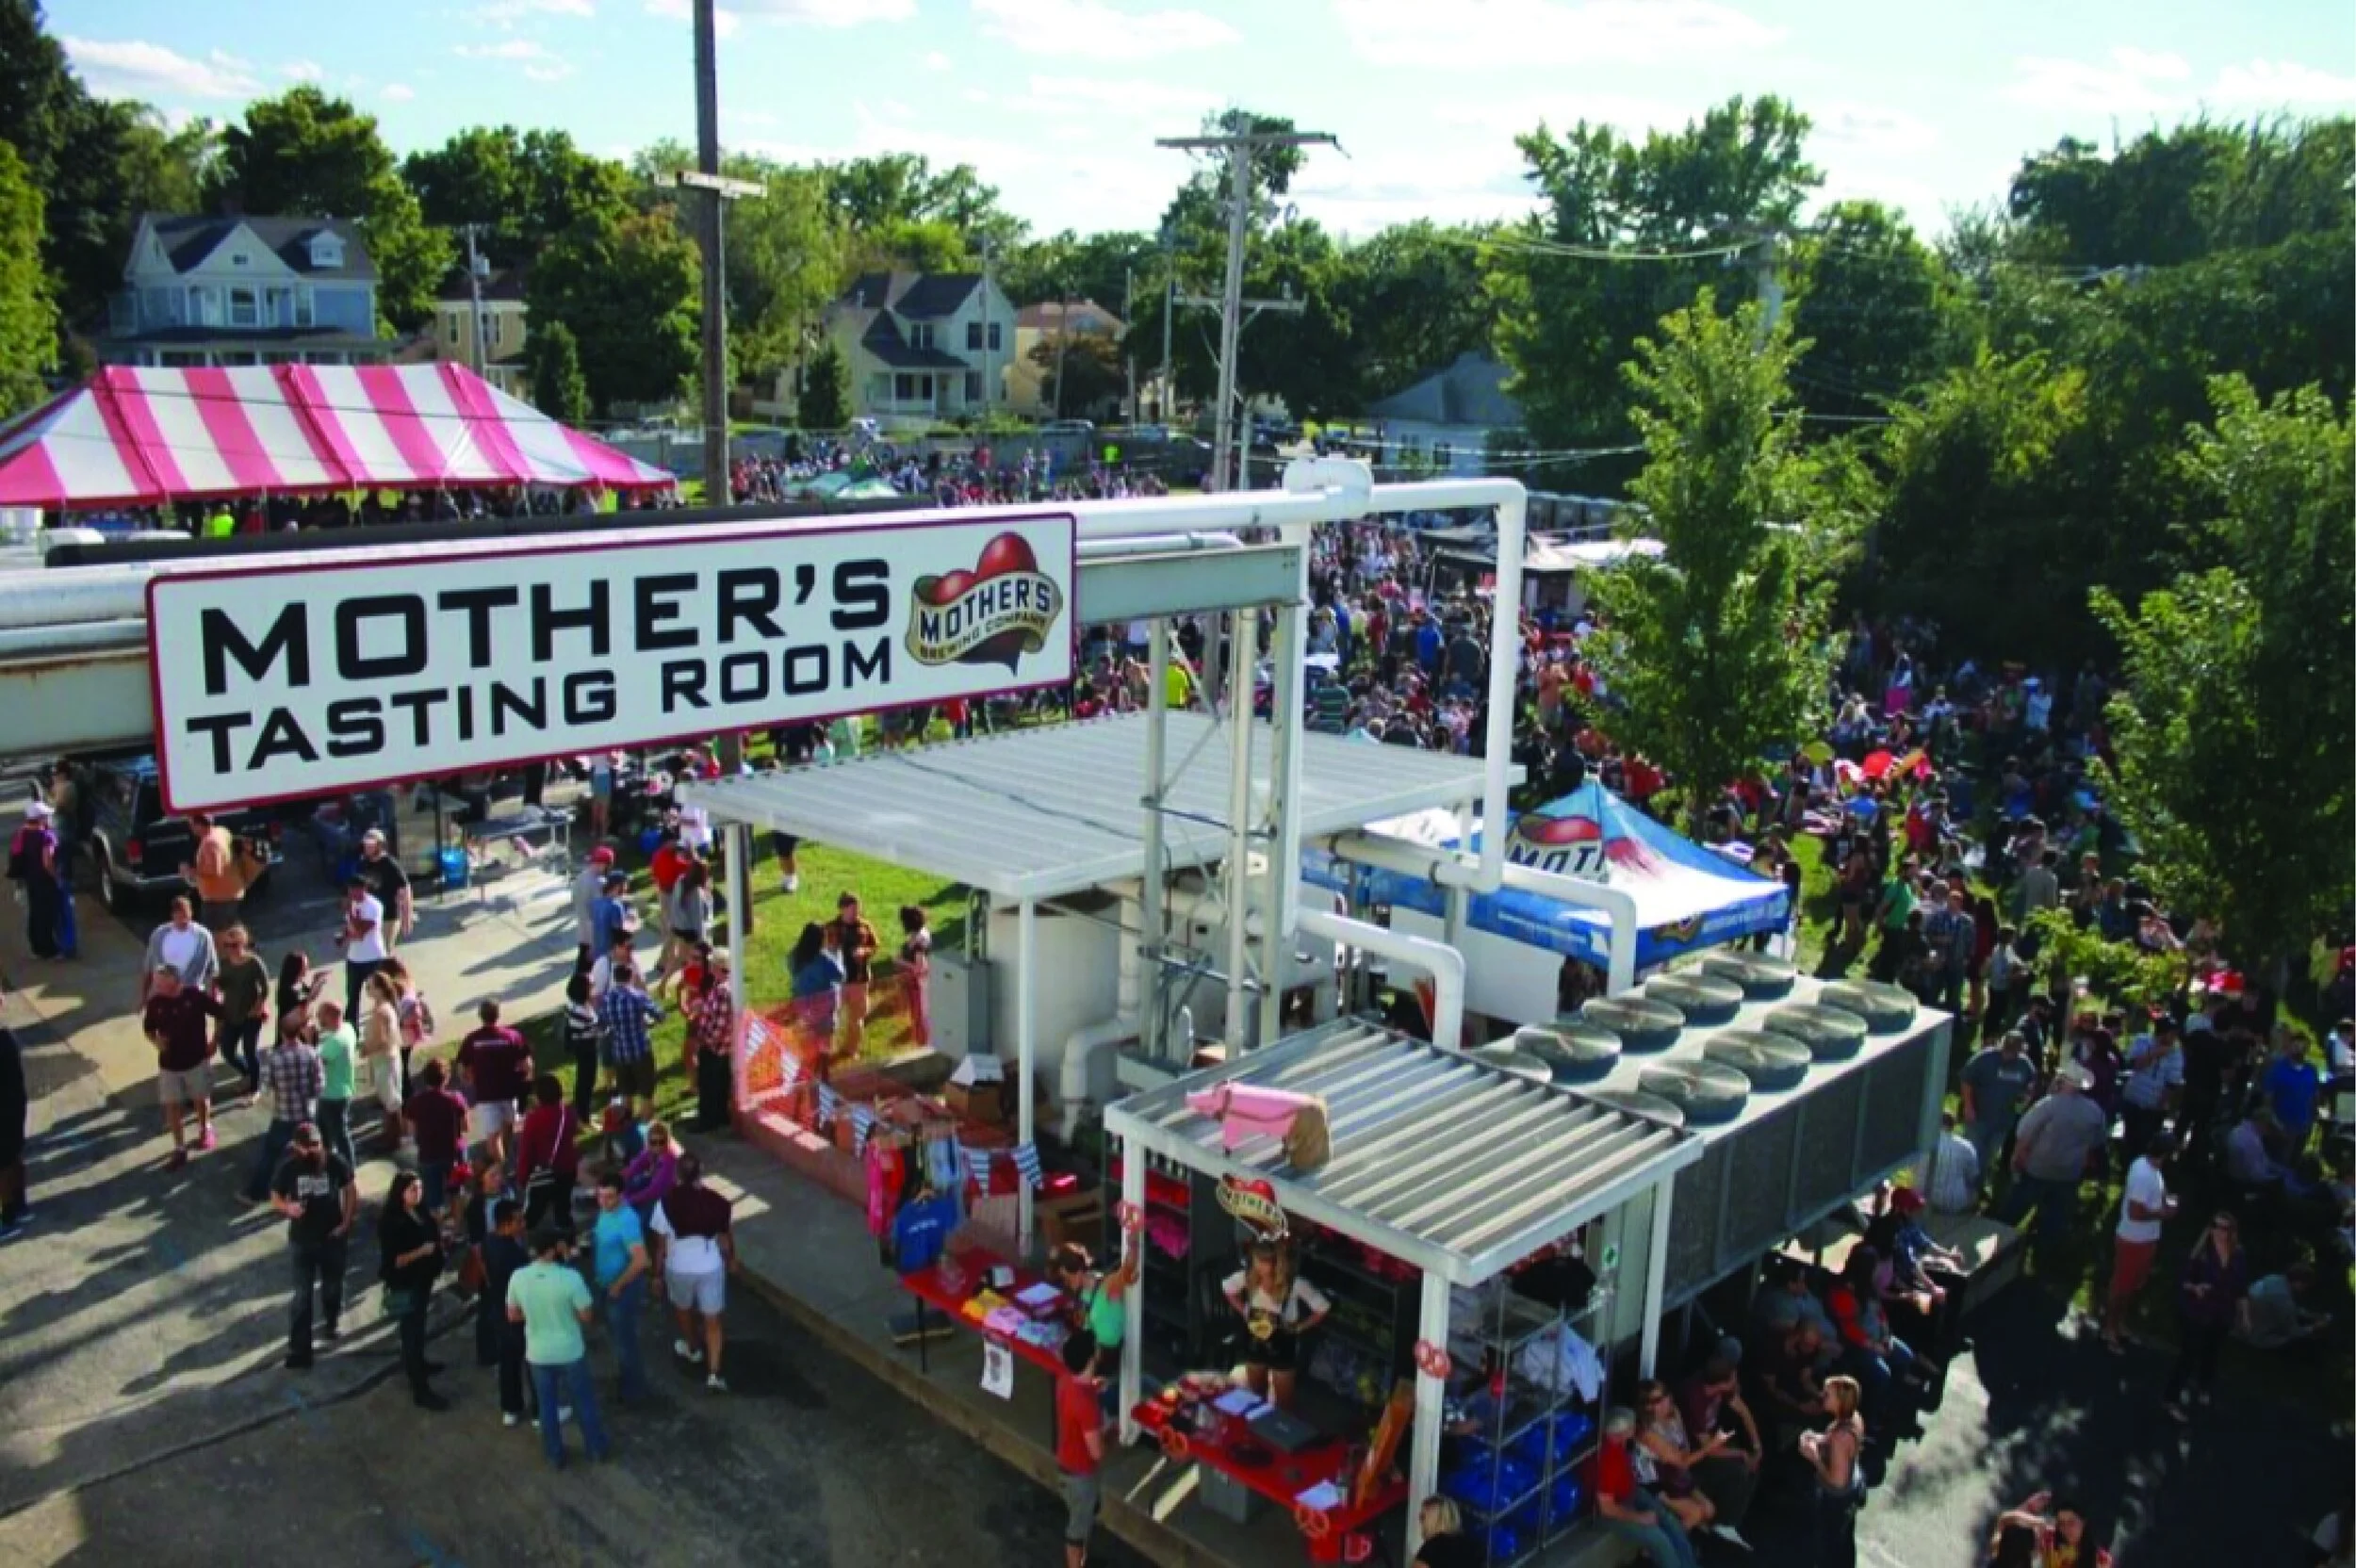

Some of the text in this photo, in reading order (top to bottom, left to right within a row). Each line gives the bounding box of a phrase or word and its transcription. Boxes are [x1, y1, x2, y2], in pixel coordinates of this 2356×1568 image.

[201, 559, 891, 696] MOTHER'S
[920, 579, 1051, 644] MOTHER'S
[187, 635, 892, 775] TASTING ROOM
